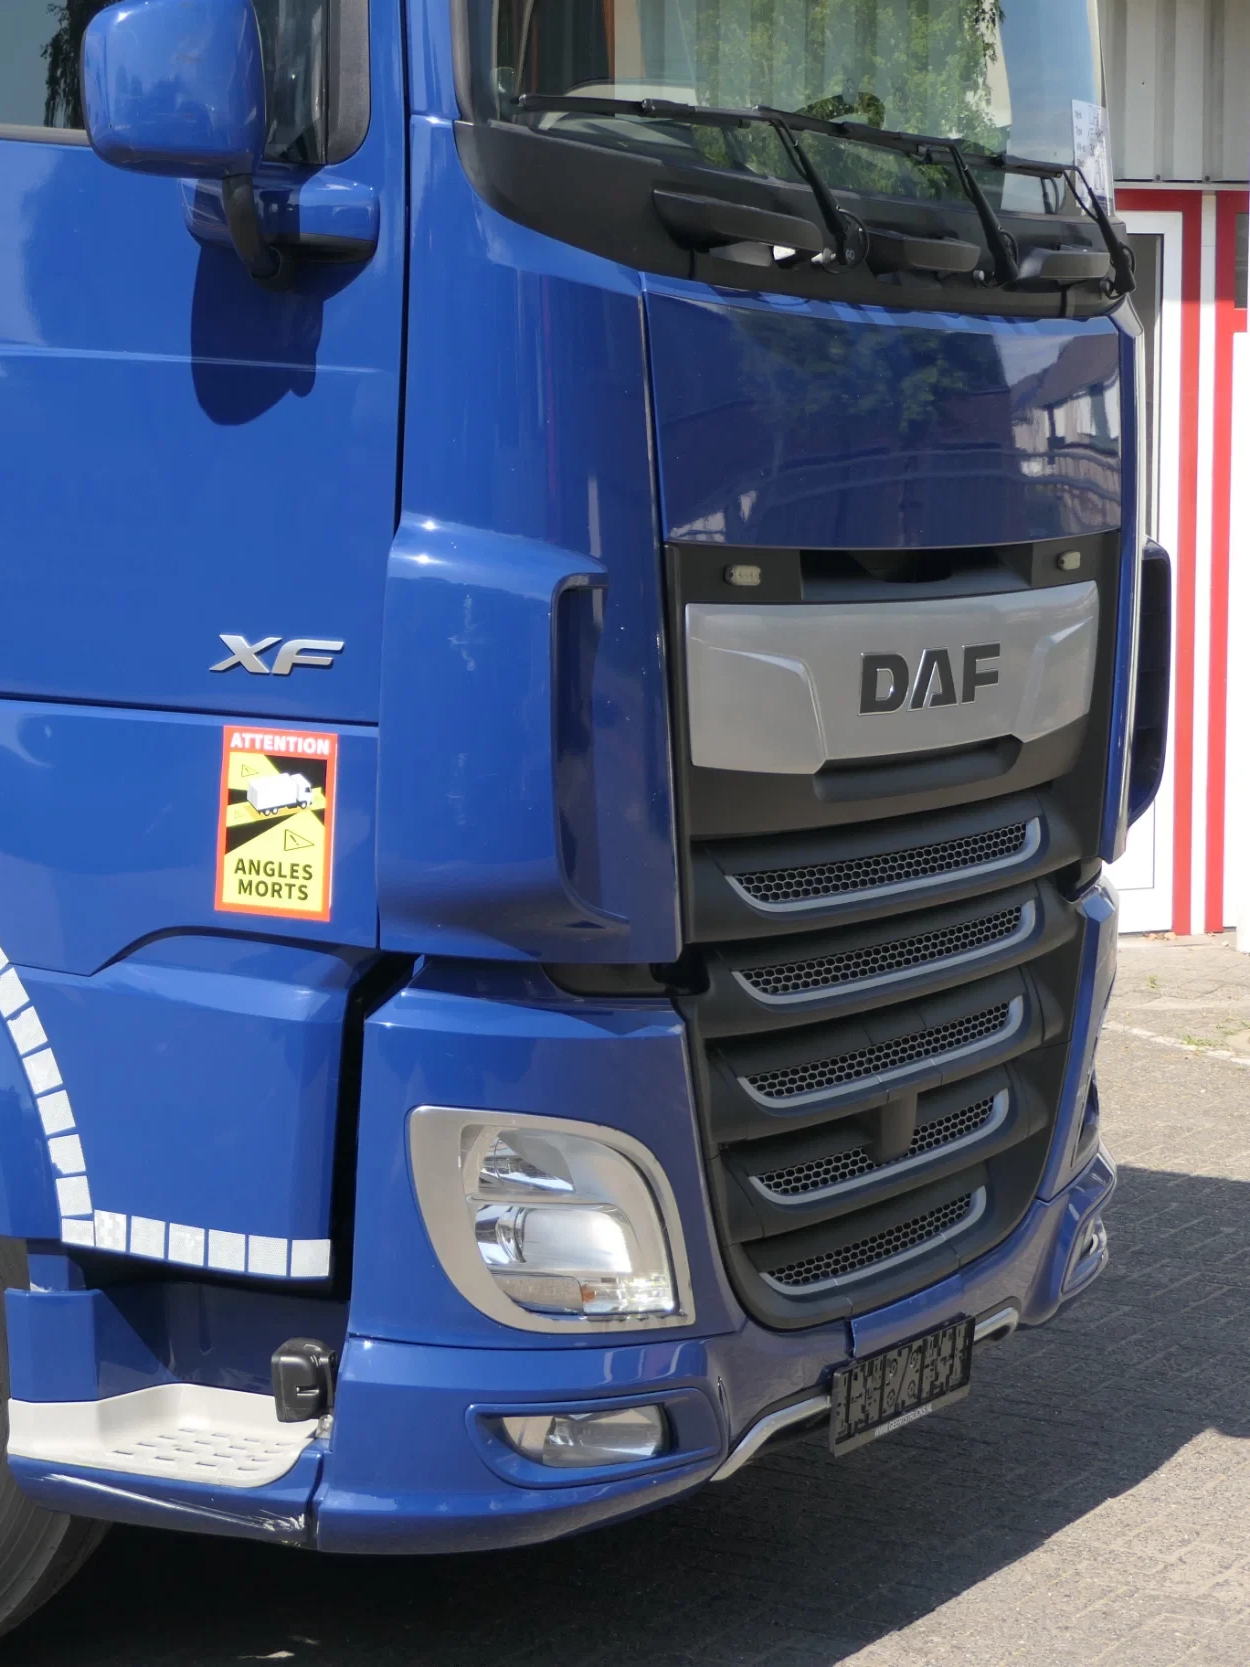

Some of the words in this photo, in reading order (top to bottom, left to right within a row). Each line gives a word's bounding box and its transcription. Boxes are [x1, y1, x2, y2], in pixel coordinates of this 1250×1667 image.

[209, 634, 345, 676] XF
[857, 641, 1001, 715] DAF
[230, 732, 330, 755] ATTENTION
[234, 858, 313, 881] ANGLES
[238, 879, 309, 901] MORTS
